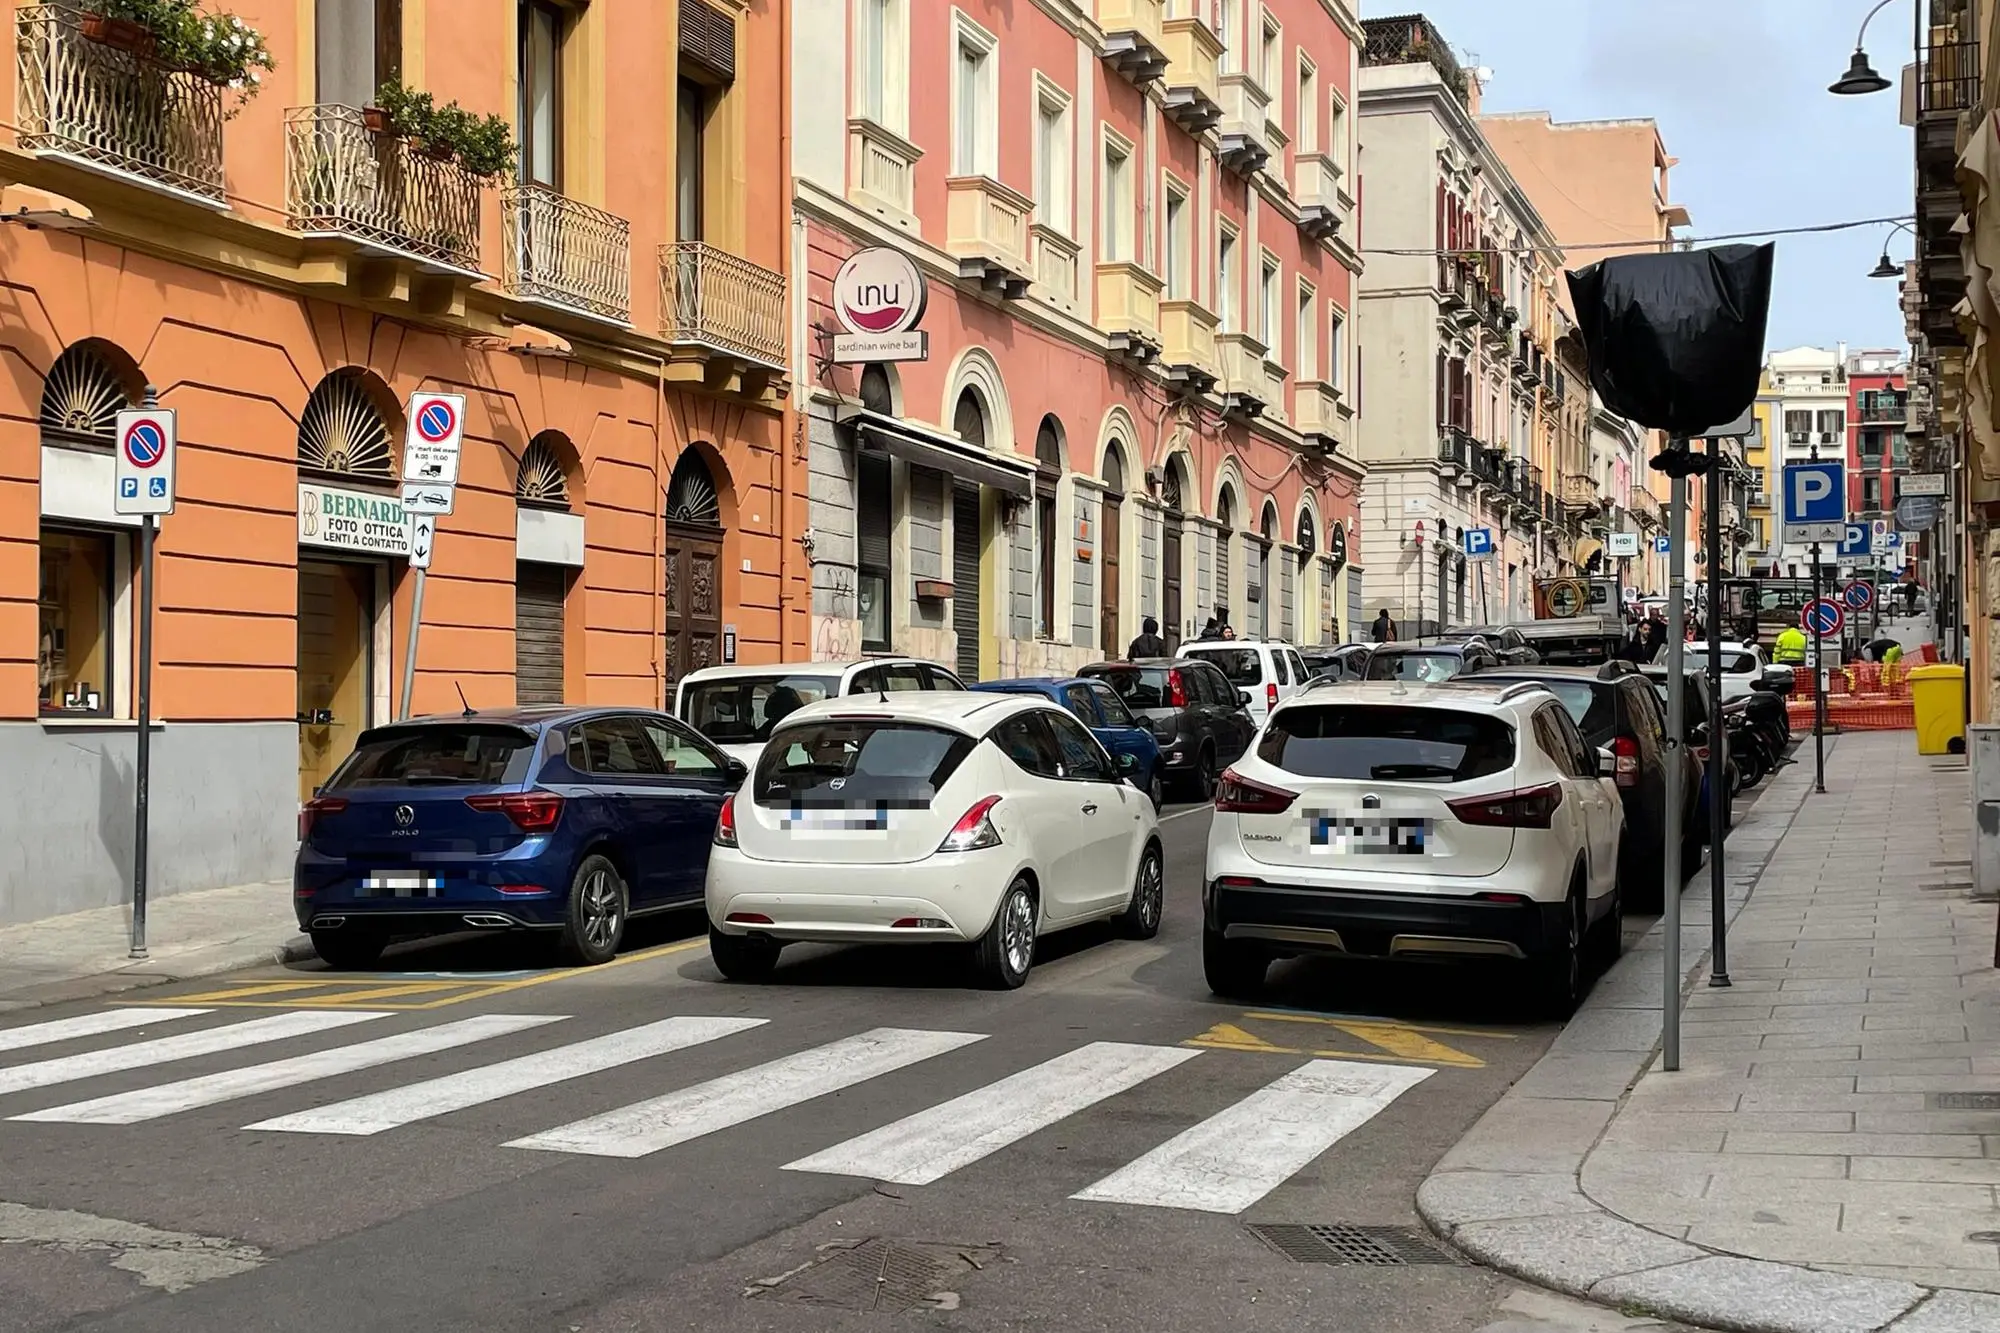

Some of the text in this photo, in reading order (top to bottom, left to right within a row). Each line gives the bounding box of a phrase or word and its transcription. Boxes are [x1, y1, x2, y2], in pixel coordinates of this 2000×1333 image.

[837, 339, 918, 352] sardinian wine bar
[124, 480, 136, 496] P
[1795, 470, 1832, 517] P
[322, 493, 408, 525] BERNARDI
[328, 518, 403, 538] FOTO OTTICA
[324, 531, 407, 550] LENTI A CONTATTO
[1470, 532, 1486, 552] P
[1657, 538, 1668, 551] P
[1843, 527, 1863, 552] P
[1887, 533, 1897, 546] P
